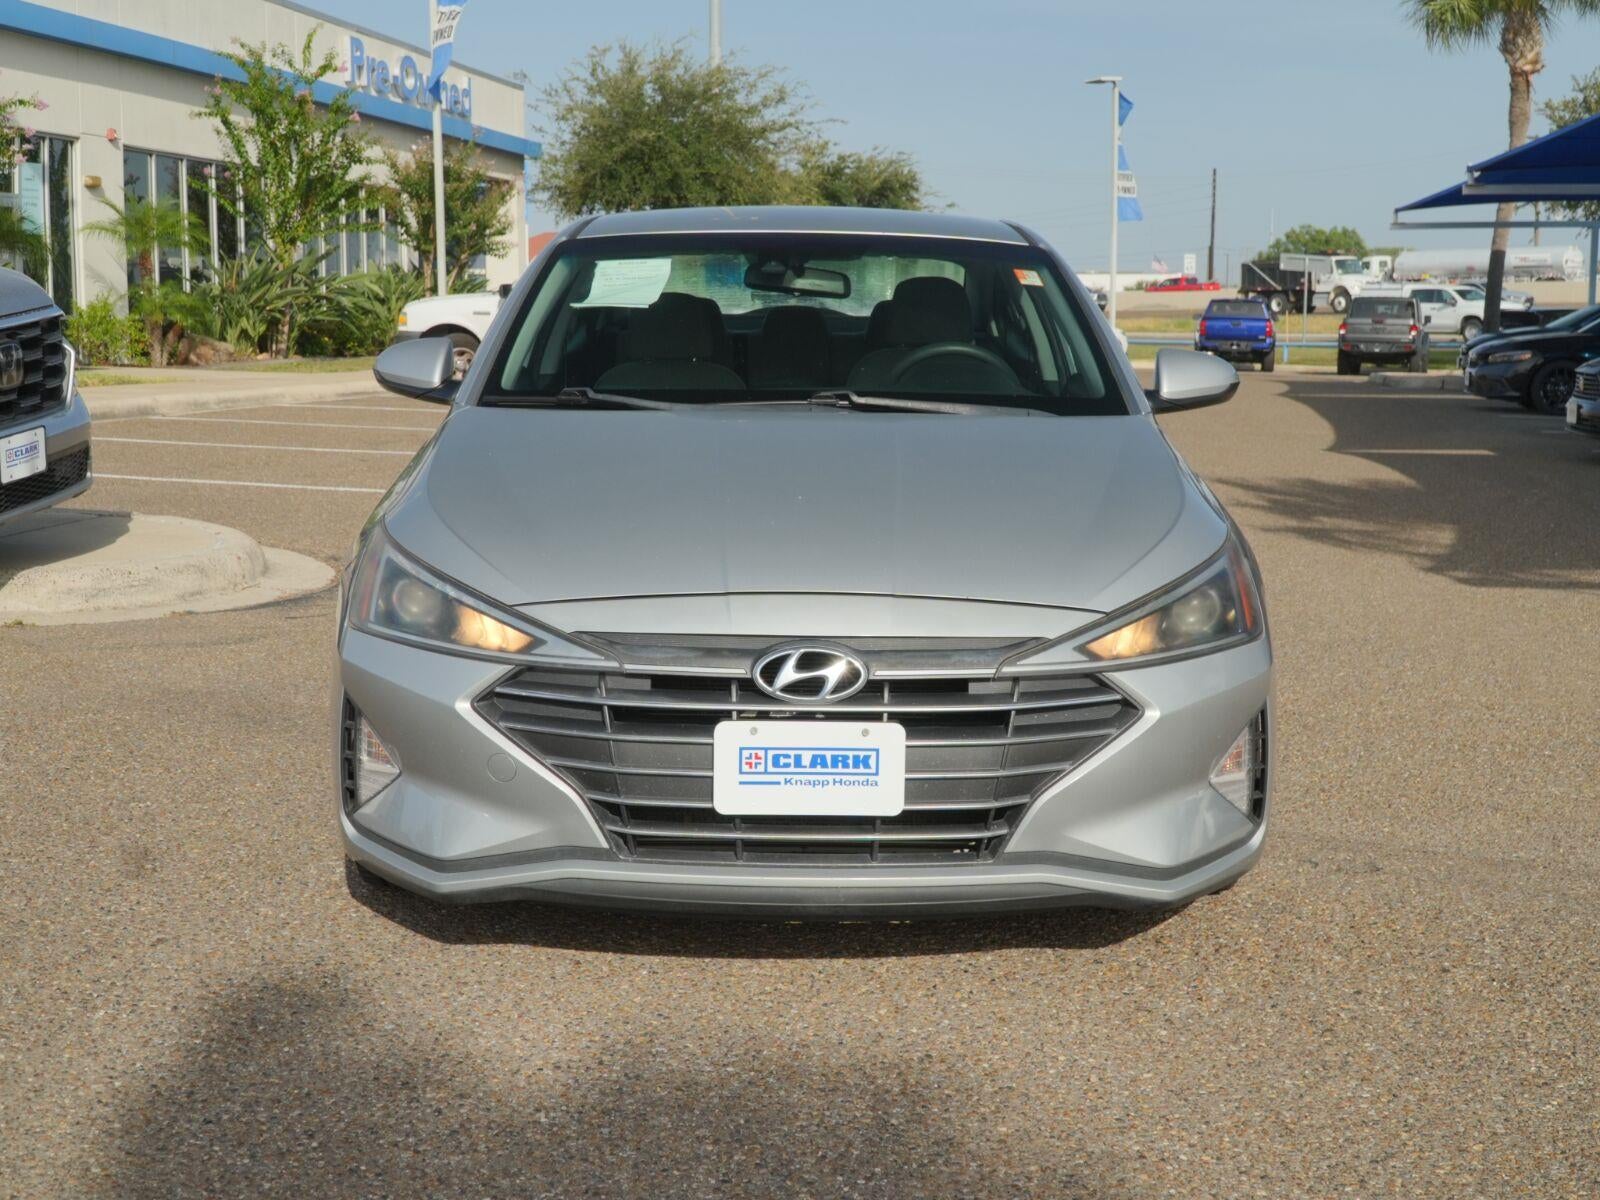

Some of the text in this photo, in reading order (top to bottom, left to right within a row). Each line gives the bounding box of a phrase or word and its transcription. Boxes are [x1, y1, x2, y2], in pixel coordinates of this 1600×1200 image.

[14, 443, 38, 458] CLARK
[771, 753, 872, 770] CLARK
[783, 777, 879, 788] Knapp Honda
